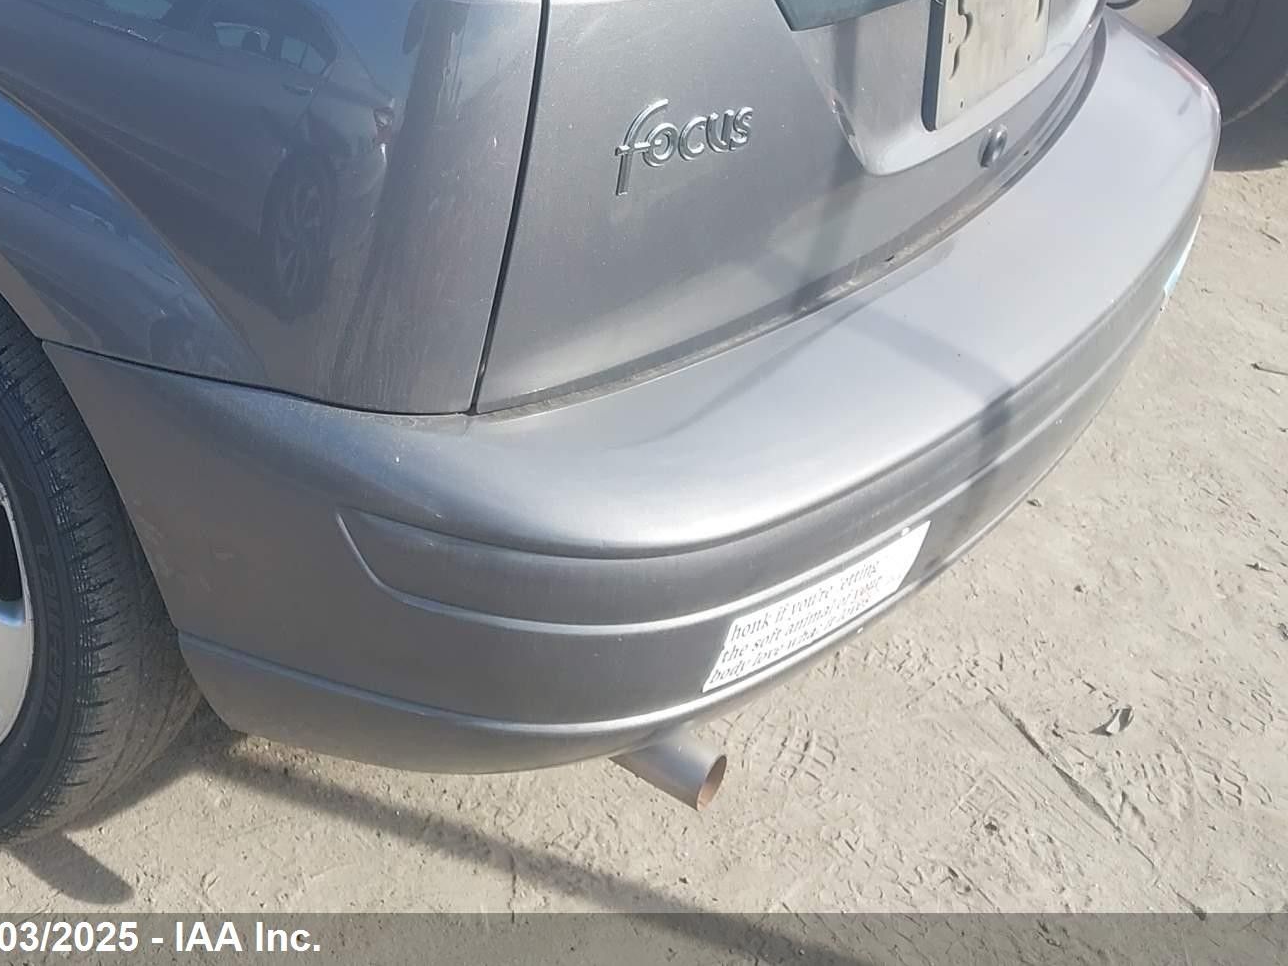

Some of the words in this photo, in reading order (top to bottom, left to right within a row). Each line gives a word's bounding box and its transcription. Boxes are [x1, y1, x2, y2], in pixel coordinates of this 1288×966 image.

[730, 612, 770, 642] honk
[722, 643, 749, 663] the
[751, 627, 783, 652] soft
